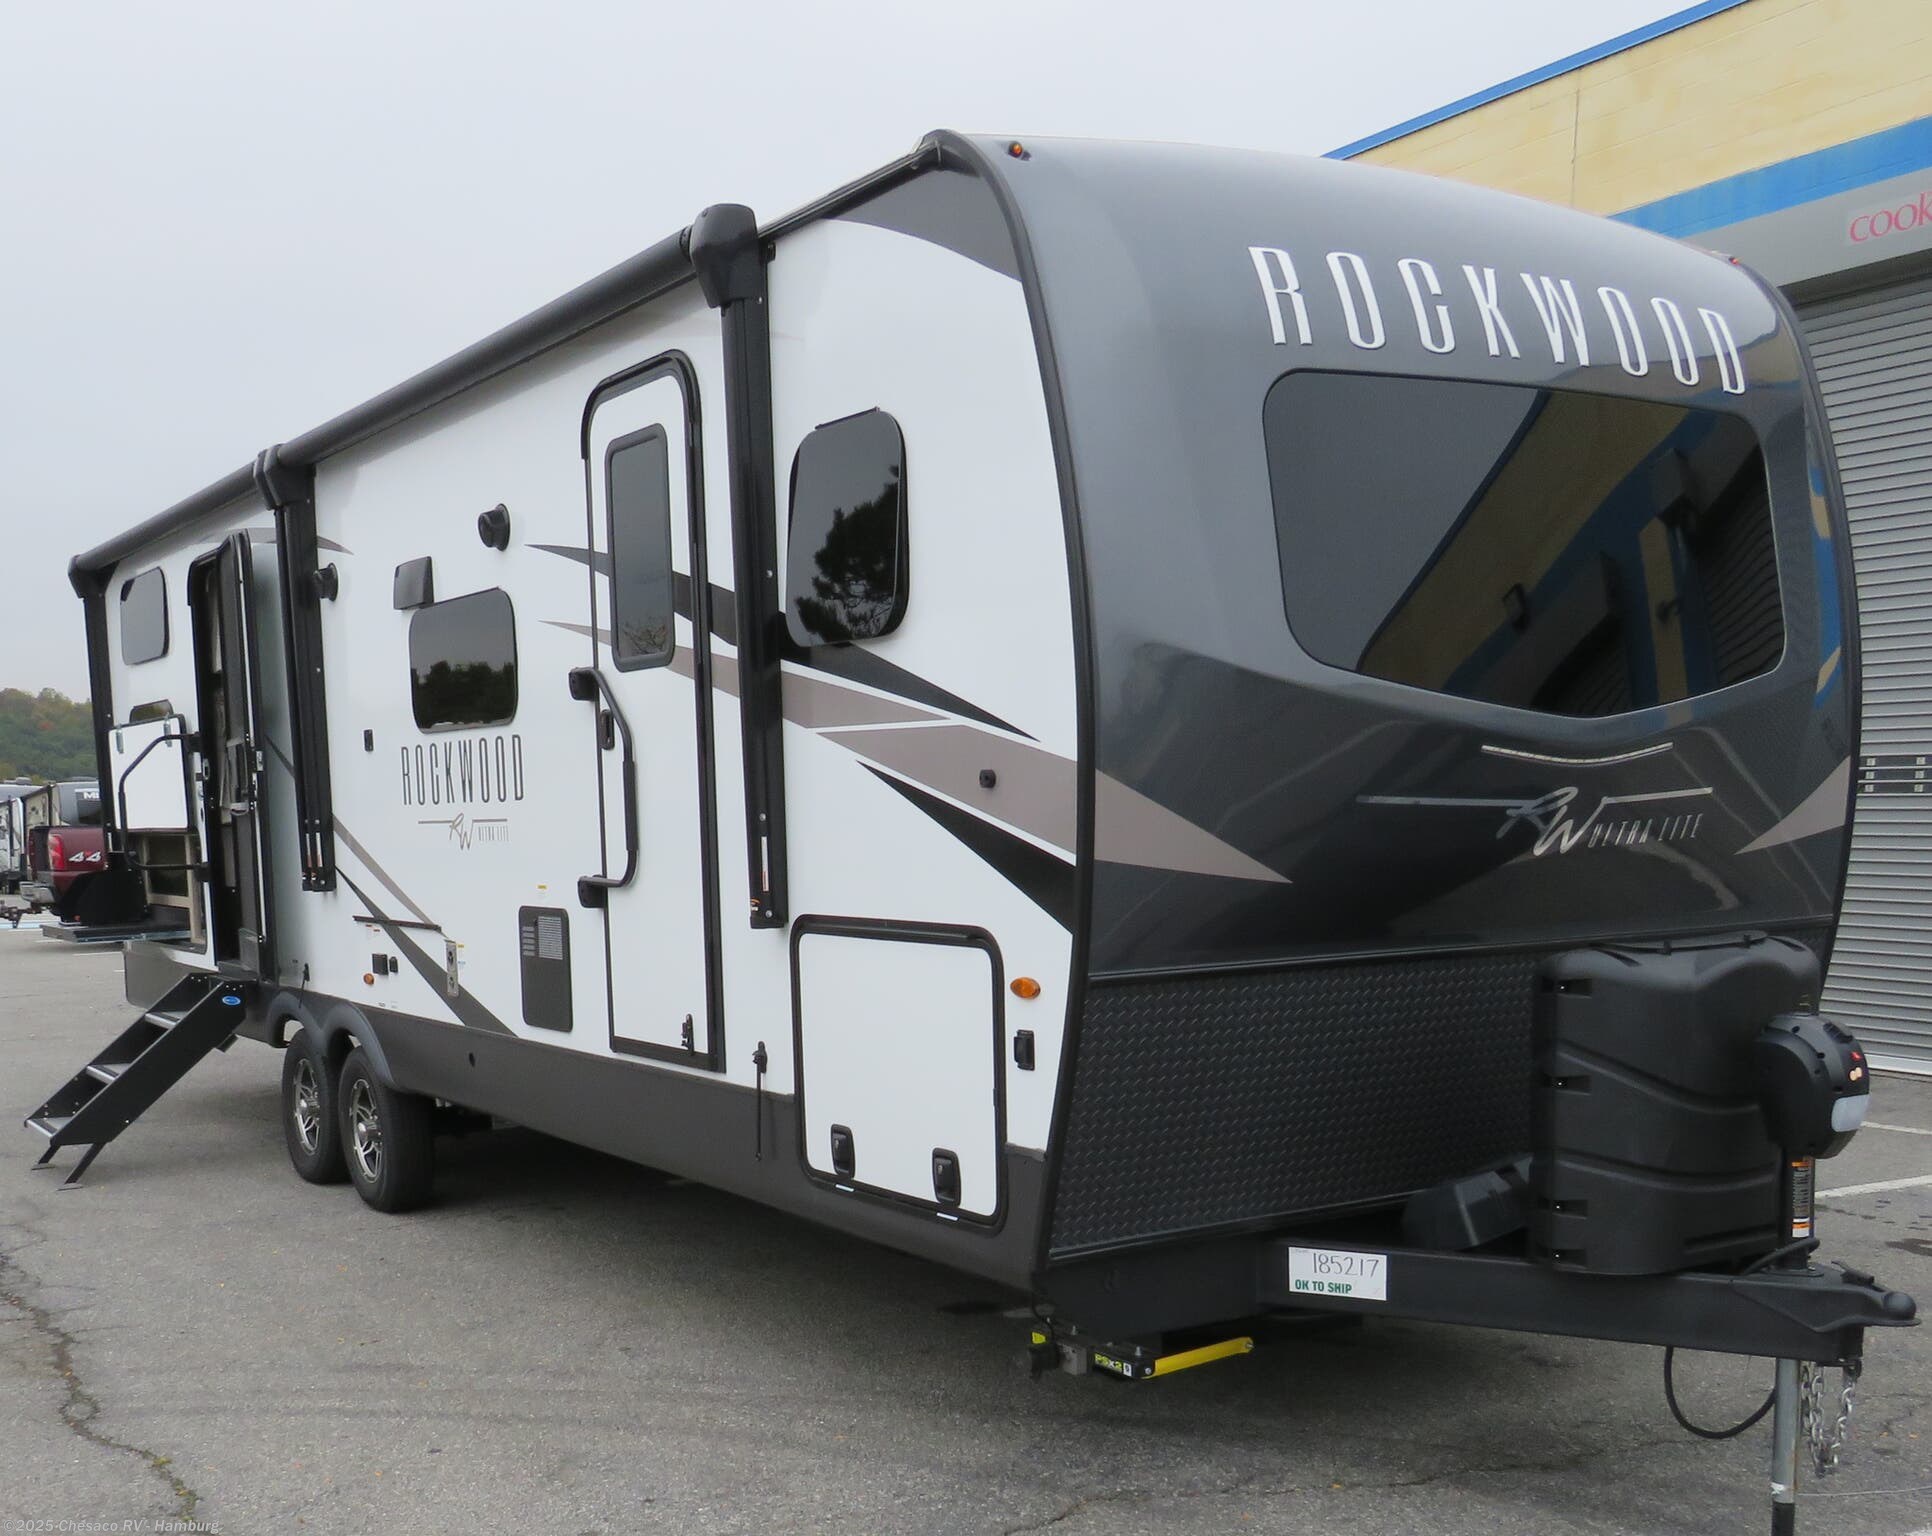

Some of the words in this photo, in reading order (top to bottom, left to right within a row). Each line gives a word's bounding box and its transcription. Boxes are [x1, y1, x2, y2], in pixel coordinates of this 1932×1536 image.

[1248, 246, 1746, 395] ROCKWOOD
[401, 734, 524, 806] ROCKWOOD
[1587, 818, 1653, 848] ULTRA
[1658, 813, 1704, 842] LITE
[1313, 1252, 1380, 1278] 185217
[1295, 1279, 1309, 1291] OK
[1312, 1281, 1325, 1292] TO
[1327, 1282, 1352, 1294] SHIP
